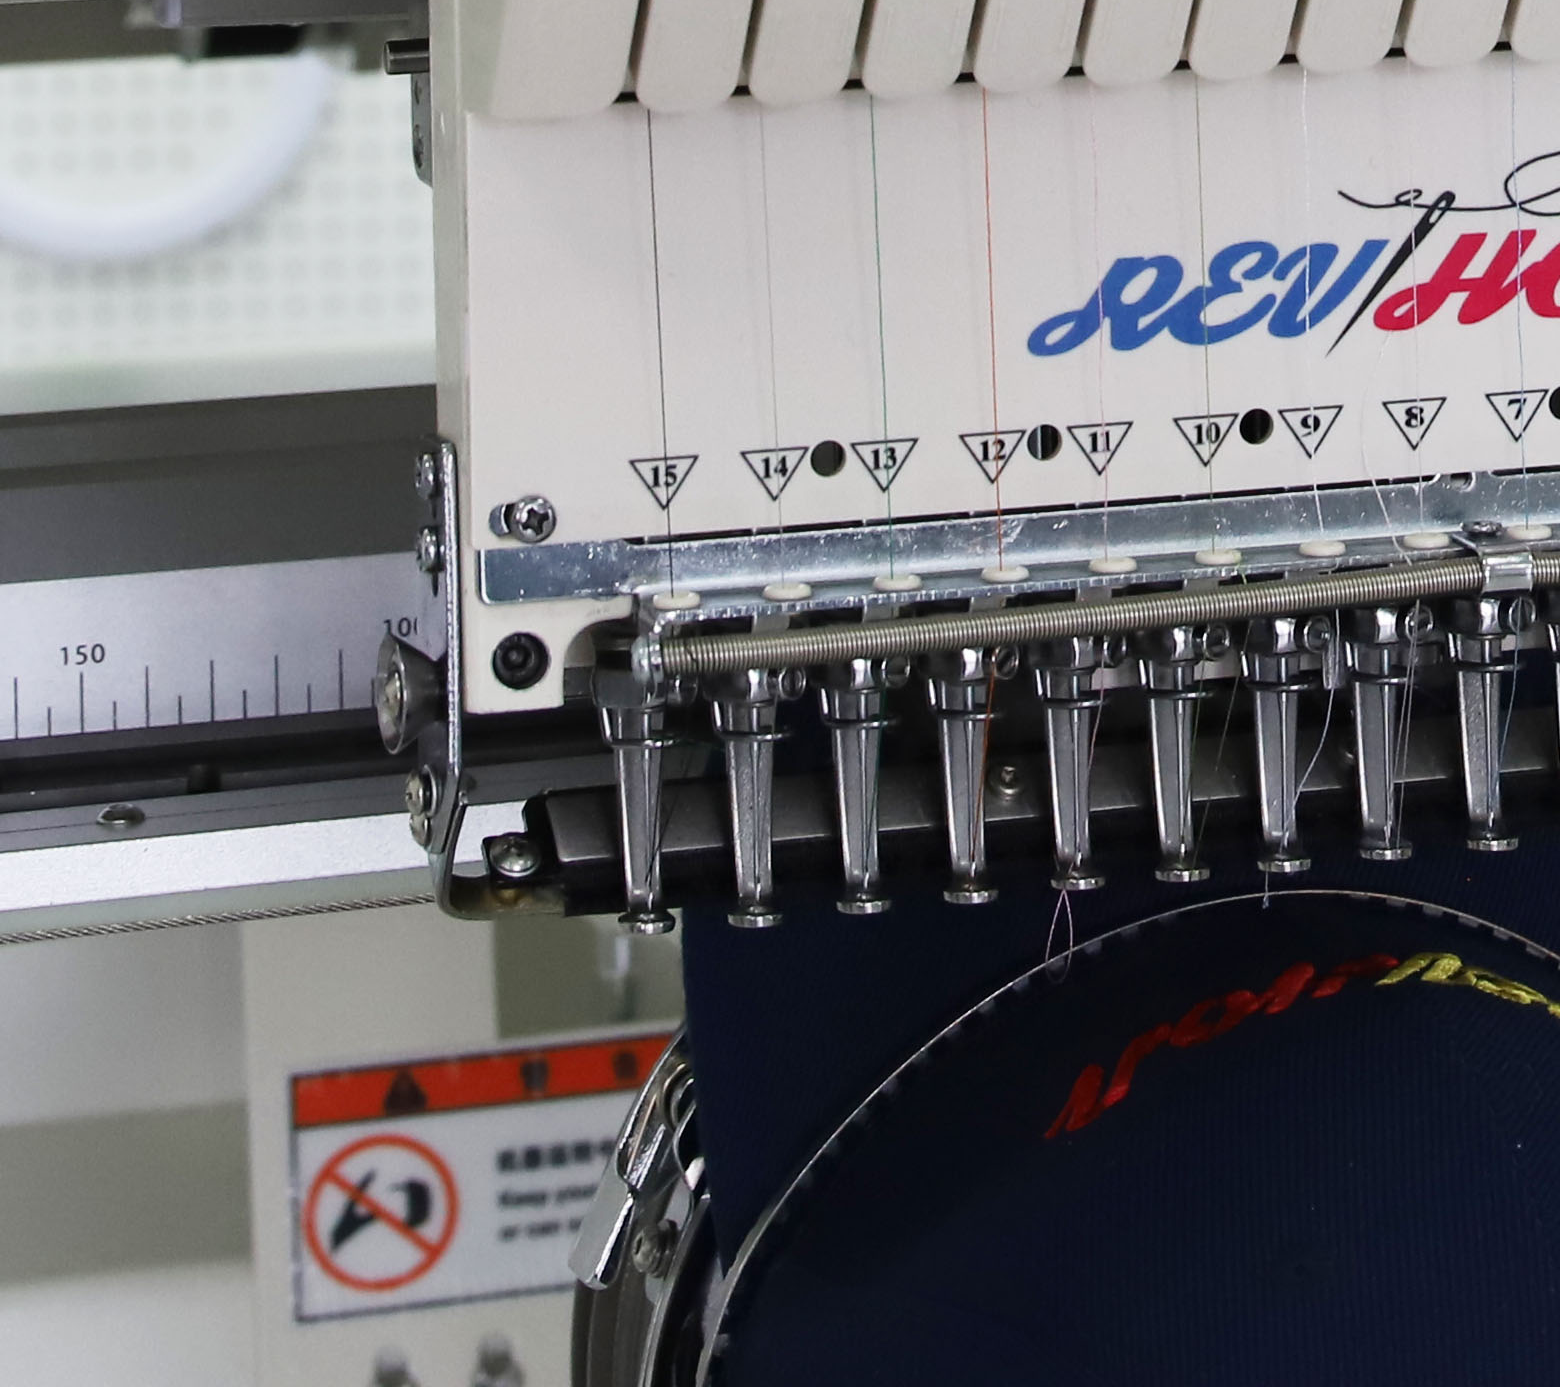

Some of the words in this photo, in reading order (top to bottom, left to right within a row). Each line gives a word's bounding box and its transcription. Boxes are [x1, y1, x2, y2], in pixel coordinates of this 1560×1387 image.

[650, 464, 678, 488] 15
[761, 455, 789, 479] 14
[870, 446, 898, 472] 13
[979, 438, 1007, 462] 12
[1088, 430, 1113, 454] 11
[1192, 421, 1221, 446] 10
[1299, 413, 1322, 439] 9
[1404, 405, 1425, 429] 8
[1506, 397, 1528, 421] 7
[58, 642, 107, 667] 150
[383, 616, 418, 638] 10
